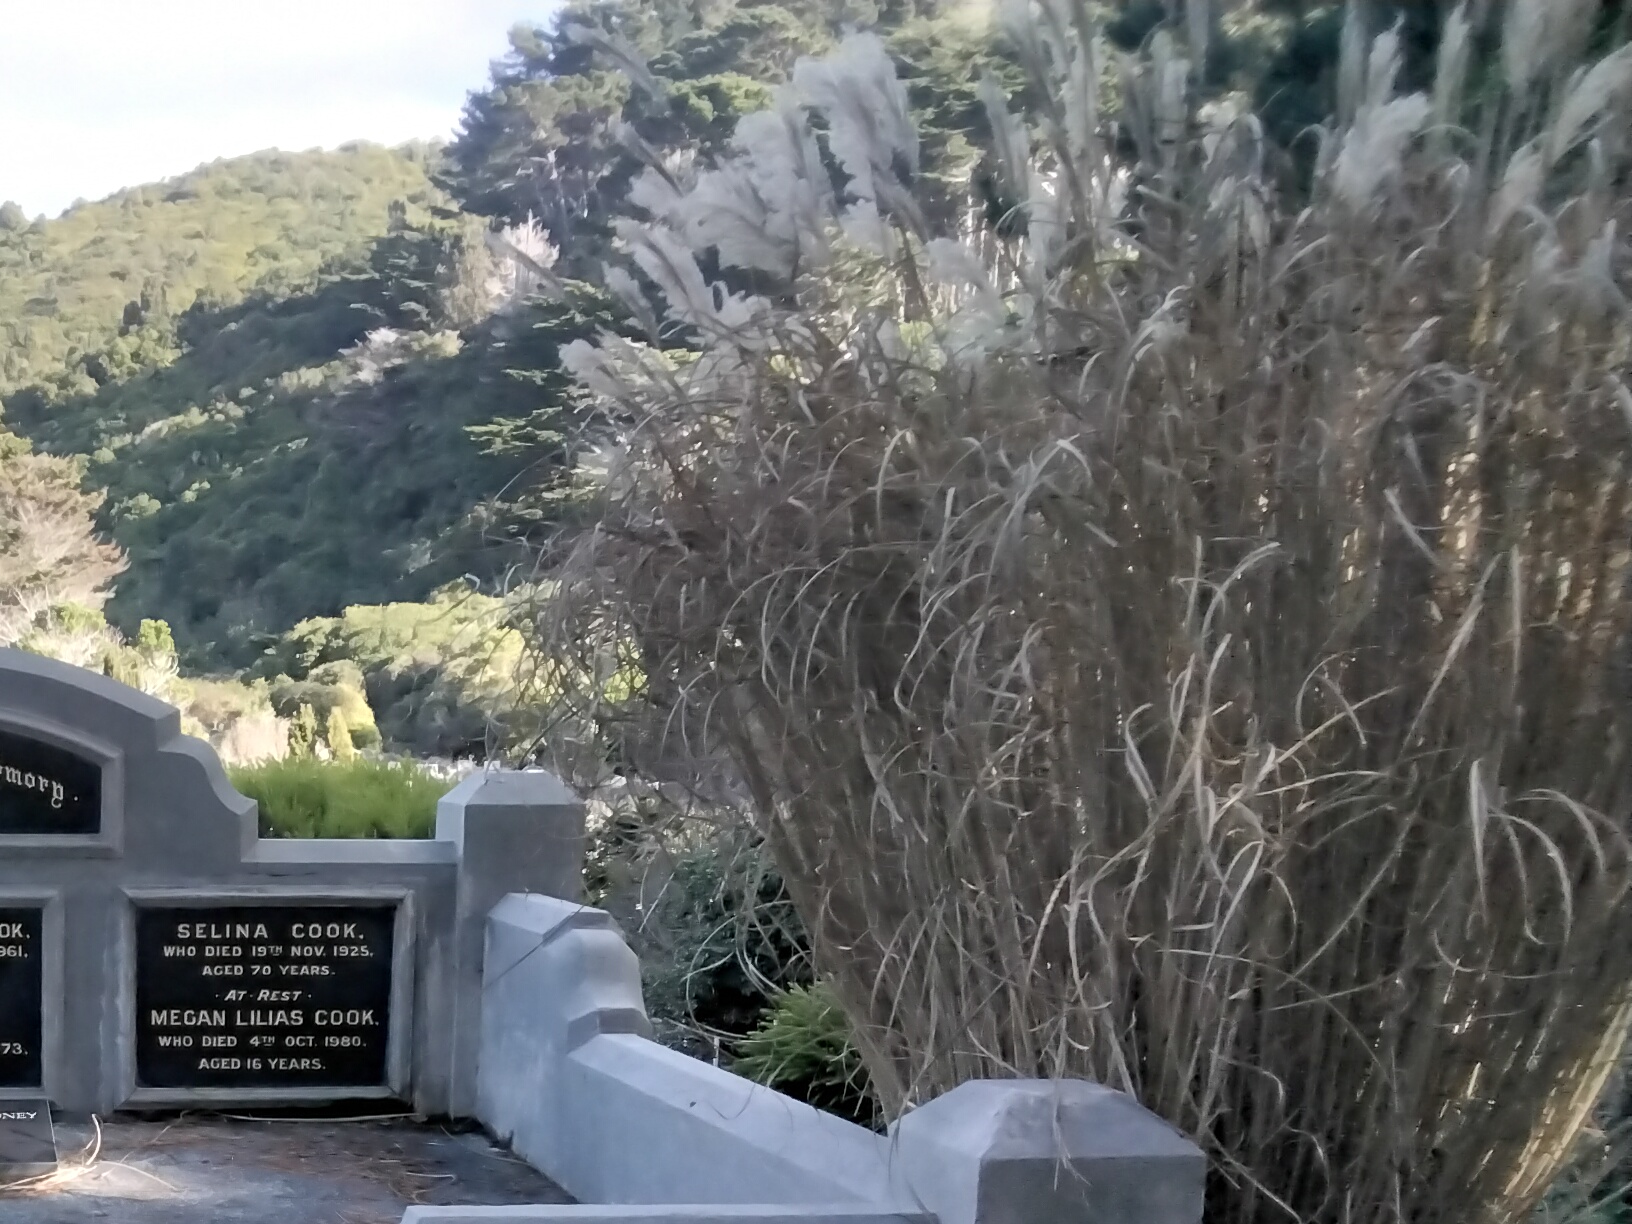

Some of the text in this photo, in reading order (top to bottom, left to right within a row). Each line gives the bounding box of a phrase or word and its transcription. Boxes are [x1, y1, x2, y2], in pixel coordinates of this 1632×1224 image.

[178, 924, 268, 938] SELINA
[164, 946, 196, 957] WHO
[205, 946, 242, 956] DIED
[291, 946, 325, 956] NOV.
[202, 965, 243, 975] AGED
[251, 965, 271, 975] 70
[151, 1010, 225, 1026] MEGAN
[236, 1010, 303, 1025] LILIAS
[159, 1036, 193, 1047] WHO
[202, 1036, 237, 1047] DIED
[285, 1036, 317, 1047] OCT.
[198, 1058, 240, 1069] AGED
[247, 1058, 261, 1069] 16
